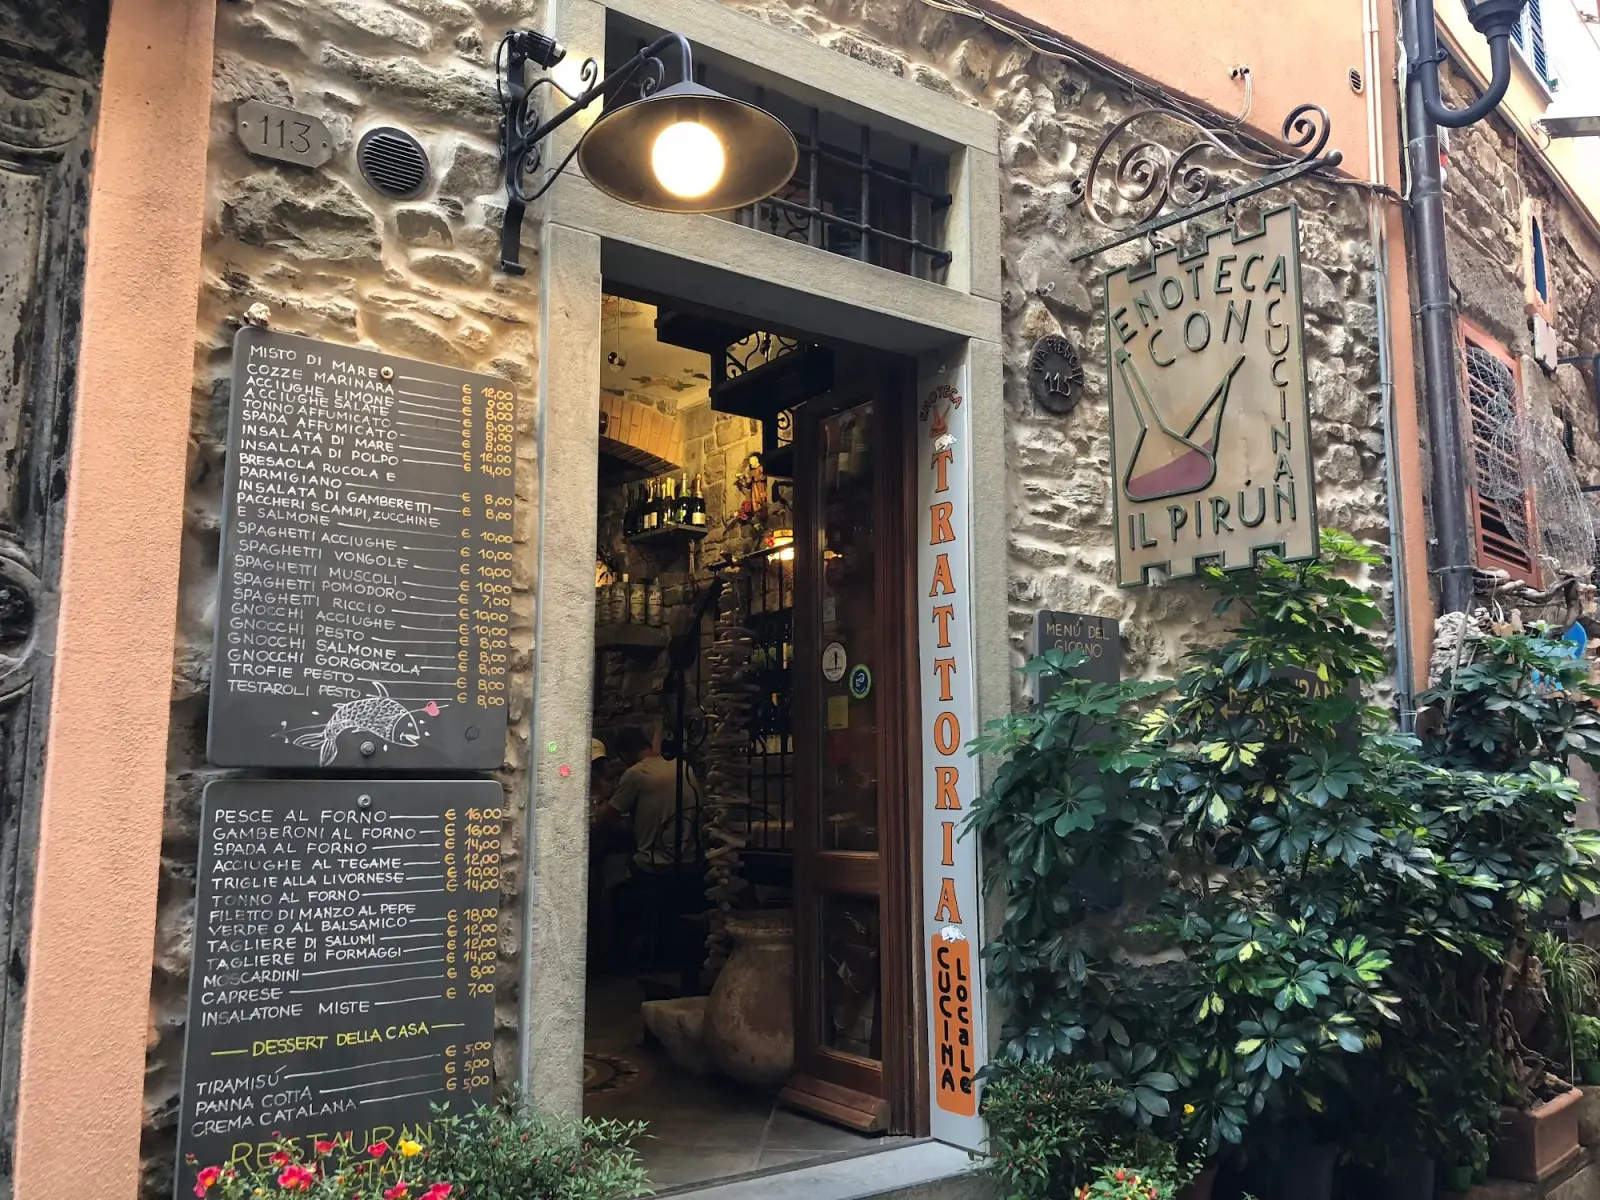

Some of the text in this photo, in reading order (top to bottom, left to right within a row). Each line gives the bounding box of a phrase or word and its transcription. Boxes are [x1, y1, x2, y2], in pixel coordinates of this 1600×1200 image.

[259, 115, 310, 153] 113
[1111, 255, 1286, 344] ENOTECA
[1148, 299, 1251, 366] CON
[247, 363, 303, 379] COZZE
[314, 371, 394, 394] MARINARA
[250, 345, 513, 400] MISTO DI MARE 12,00
[1265, 299, 1294, 481] CUCINA
[244, 388, 514, 434] ACCIUGHE SALATE 8,00
[246, 376, 513, 421] ACCIUGHE LIMONE 8,00
[242, 398, 513, 442] TONNO AFFUMICATO 8,00
[242, 410, 512, 453] SPADA AFFUMICATO 8,00
[240, 440, 511, 477] INSALATA DI POLPO 14,00
[242, 425, 511, 463] INSALATA DI MARE 12,00
[239, 453, 396, 482] BRESAOLA RUCOLA E
[238, 480, 512, 521] INSALATA DI GAMBERETTI 8,00
[240, 466, 512, 507] PARMIGIANO 8,00
[237, 493, 305, 510] PACCHERI
[373, 511, 441, 529] ZUCCHINE
[238, 506, 513, 544] E SALMONE 10,00
[237, 521, 512, 562] SPAGHETTI ACCIUGHE 10,00
[1128, 512, 1157, 549] IL
[235, 555, 511, 596] SPAGHETTI MUSCOLI 10,00
[239, 540, 511, 579] SPAGHETTI VONGOLE 10,00
[233, 573, 510, 607] SPAGHETTI POMODORO 7,00
[233, 588, 508, 623] SPAGHETTI RICCIO 10,00
[230, 618, 507, 650] GNOCCHI PESTO 8,00
[231, 604, 508, 637] GNOCCHI ACCIUGHE 10,00
[1088, 626, 1110, 640] DEL
[228, 633, 507, 664] GNOCCHI SALMONE 8,00
[228, 649, 505, 677] GNOCCHI GORGONZOLA 8,00
[228, 679, 504, 709] TESTAROLI PESTO 8,00
[230, 664, 504, 692] TROFIE PESTO 8,00
[929, 448, 962, 924] TRATTORIA
[213, 825, 500, 840] GAMBERONI AL FORNO 16,00
[215, 808, 502, 824] PESCE AL FORNO 16,00
[212, 854, 499, 873] ACCIUGHE AL TEGAME 12,00
[213, 839, 500, 856] SPADA AL FORNO 14,00
[211, 866, 499, 890] TRIGLIE ALLA LIVORNESE 10,00
[212, 879, 499, 907] TONNO AL FORNO 14,00
[208, 908, 498, 936] VERDE O AL BALSAMICO 18,00
[209, 904, 416, 924] FILETTO DI MANZO AL PEPE
[207, 923, 498, 953] TAGLIERE DI SALUMI 12,00
[207, 937, 497, 970] TAGLIERE DI FORMAGGI 12,00
[202, 965, 496, 1005] CAPRESE 8,00
[203, 951, 496, 989] MOSCARDINI 14,00
[201, 983, 494, 1027] INSALATONE MISTE 7,00
[937, 946, 955, 1092] CUCINA
[252, 1022, 429, 1057] DESSERT DELLA CASA
[463, 1040, 491, 1054] 5,00
[196, 1058, 489, 1117] PANNA COTTA 5,00
[191, 1076, 489, 1137] CREMA CATALANA 5,00
